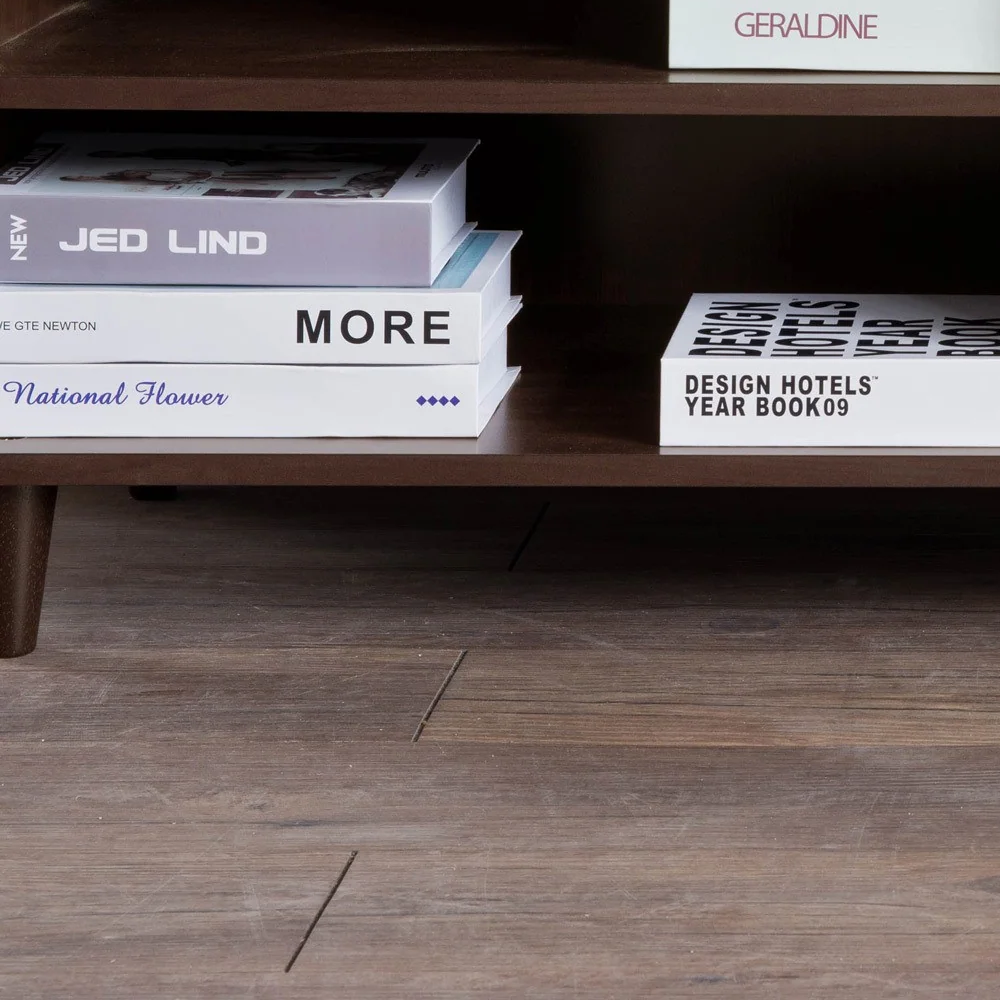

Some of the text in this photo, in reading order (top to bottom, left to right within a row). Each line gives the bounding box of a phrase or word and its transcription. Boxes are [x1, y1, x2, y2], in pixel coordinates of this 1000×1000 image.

[734, 12, 878, 39] GERALDINE
[10, 214, 28, 261] NEW
[58, 227, 267, 255] JED LIND
[15, 321, 39, 331] GTE
[43, 321, 97, 331] NEWTON
[296, 309, 451, 345] MORE
[688, 301, 781, 357] DESIGN
[771, 299, 861, 357] HOTELS
[854, 318, 935, 357] YEAR
[3, 381, 229, 406] National Flower
[685, 375, 771, 395] DESIGN
[684, 397, 746, 416] YEAR
